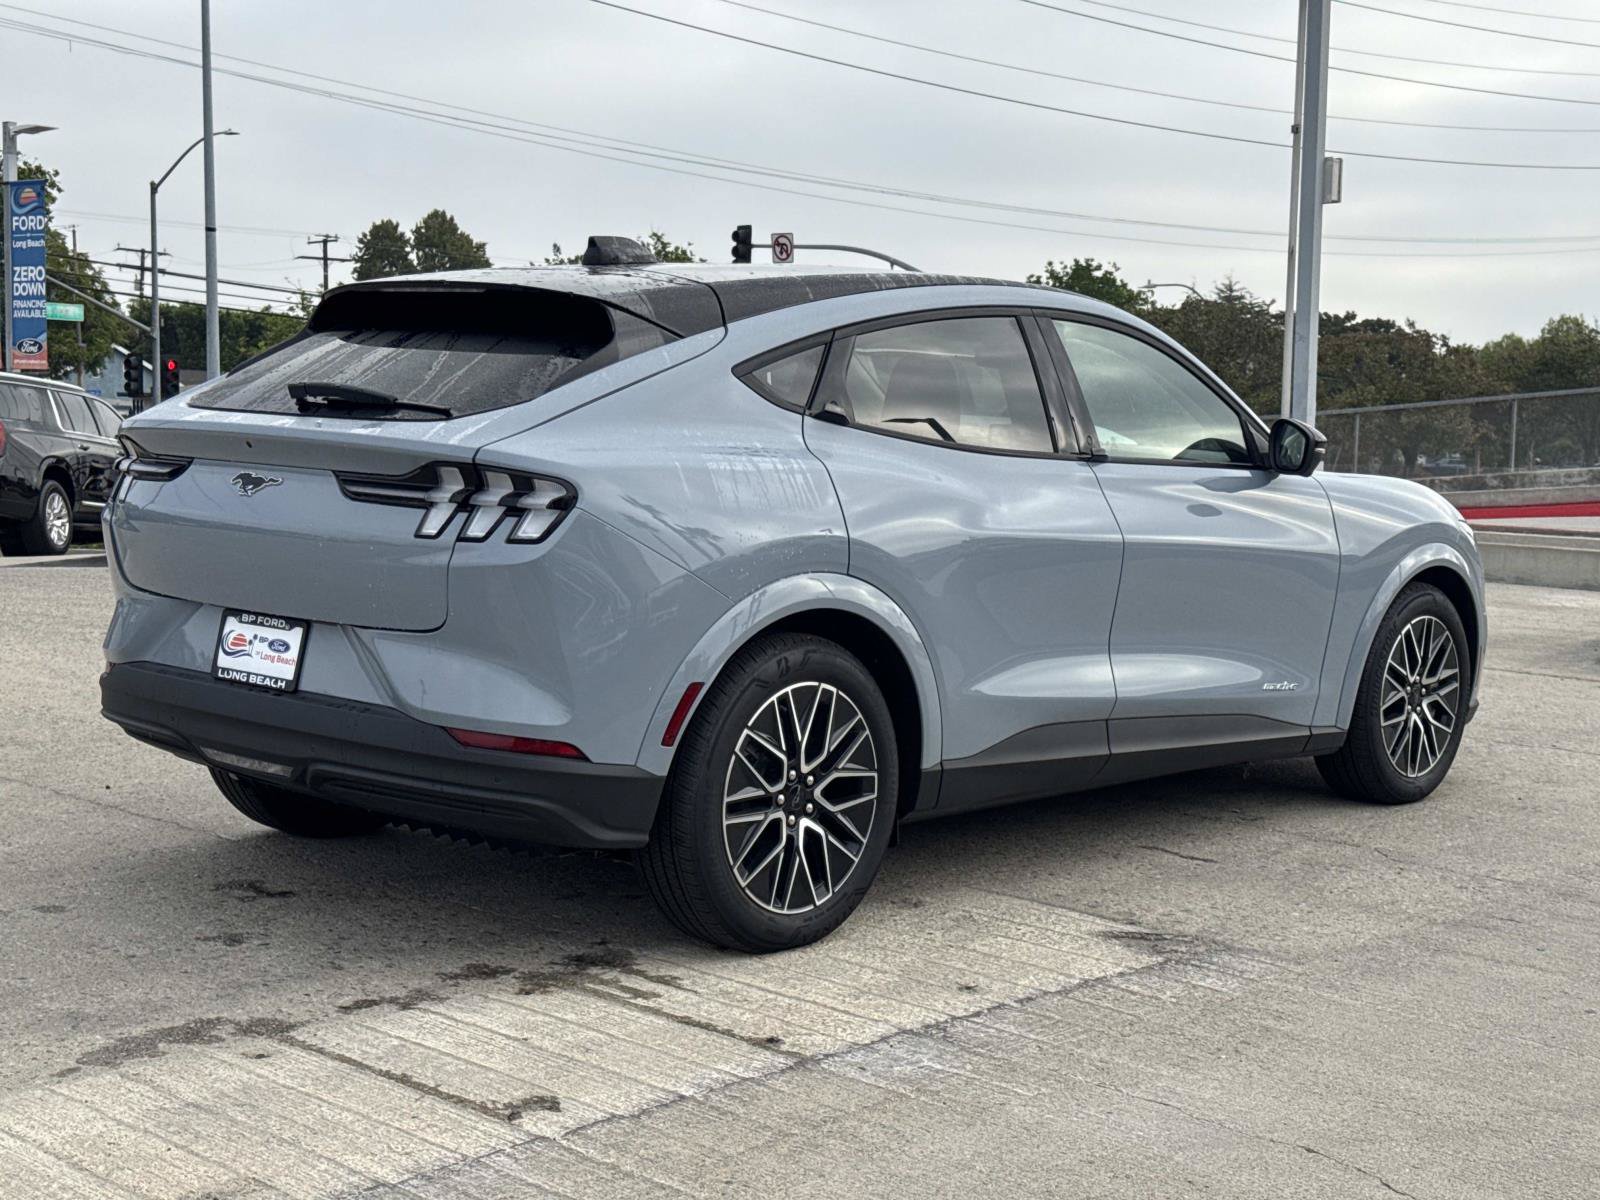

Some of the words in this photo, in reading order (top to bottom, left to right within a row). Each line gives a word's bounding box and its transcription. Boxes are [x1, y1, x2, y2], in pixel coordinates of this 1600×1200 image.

[12, 215, 45, 231] FORD
[12, 240, 27, 249] Long
[27, 239, 46, 248] Beach
[13, 265, 46, 281] ZERO
[13, 282, 46, 296] DOWN
[13, 300, 47, 308] FINANCING
[13, 309, 48, 318] AVAILABLE
[20, 340, 39, 352] Ford
[241, 613, 256, 623] BP
[257, 615, 286, 628] FORD
[270, 640, 288, 652] Ford
[260, 651, 277, 664] Long
[276, 654, 297, 666] Beach
[217, 668, 248, 682] LONG
[248, 674, 286, 689] BEACH
